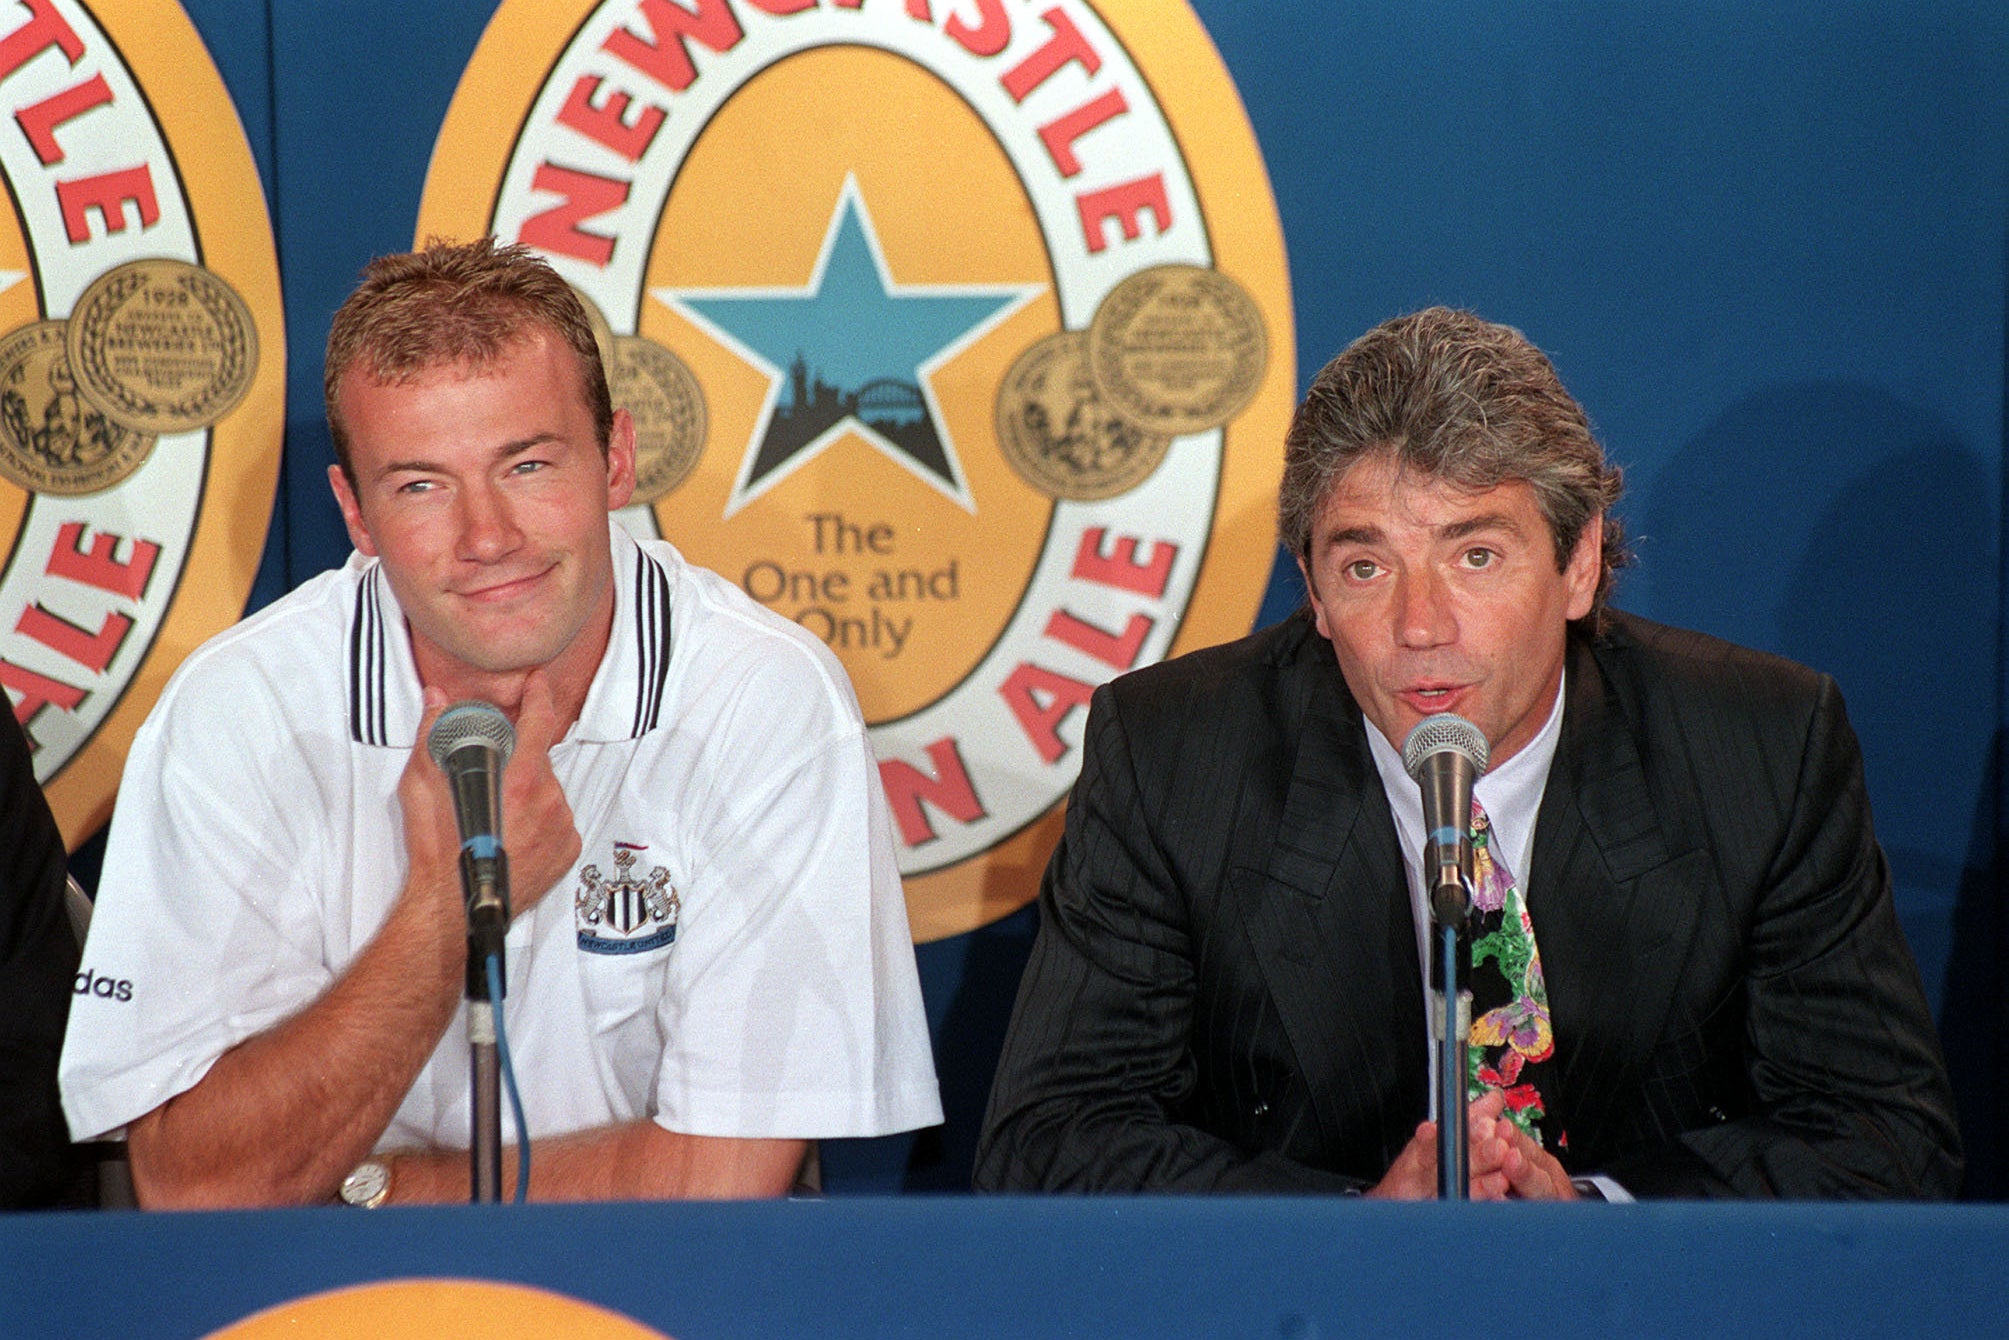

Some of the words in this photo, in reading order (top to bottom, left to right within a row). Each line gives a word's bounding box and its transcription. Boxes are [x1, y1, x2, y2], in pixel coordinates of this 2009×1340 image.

[0, 0, 161, 247] TLE
[806, 512, 893, 554] The
[743, 560, 849, 603] One
[868, 559, 960, 600] and
[795, 606, 913, 660] Only
[997, 526, 1178, 767] ALE
[73, 968, 133, 1002] das
